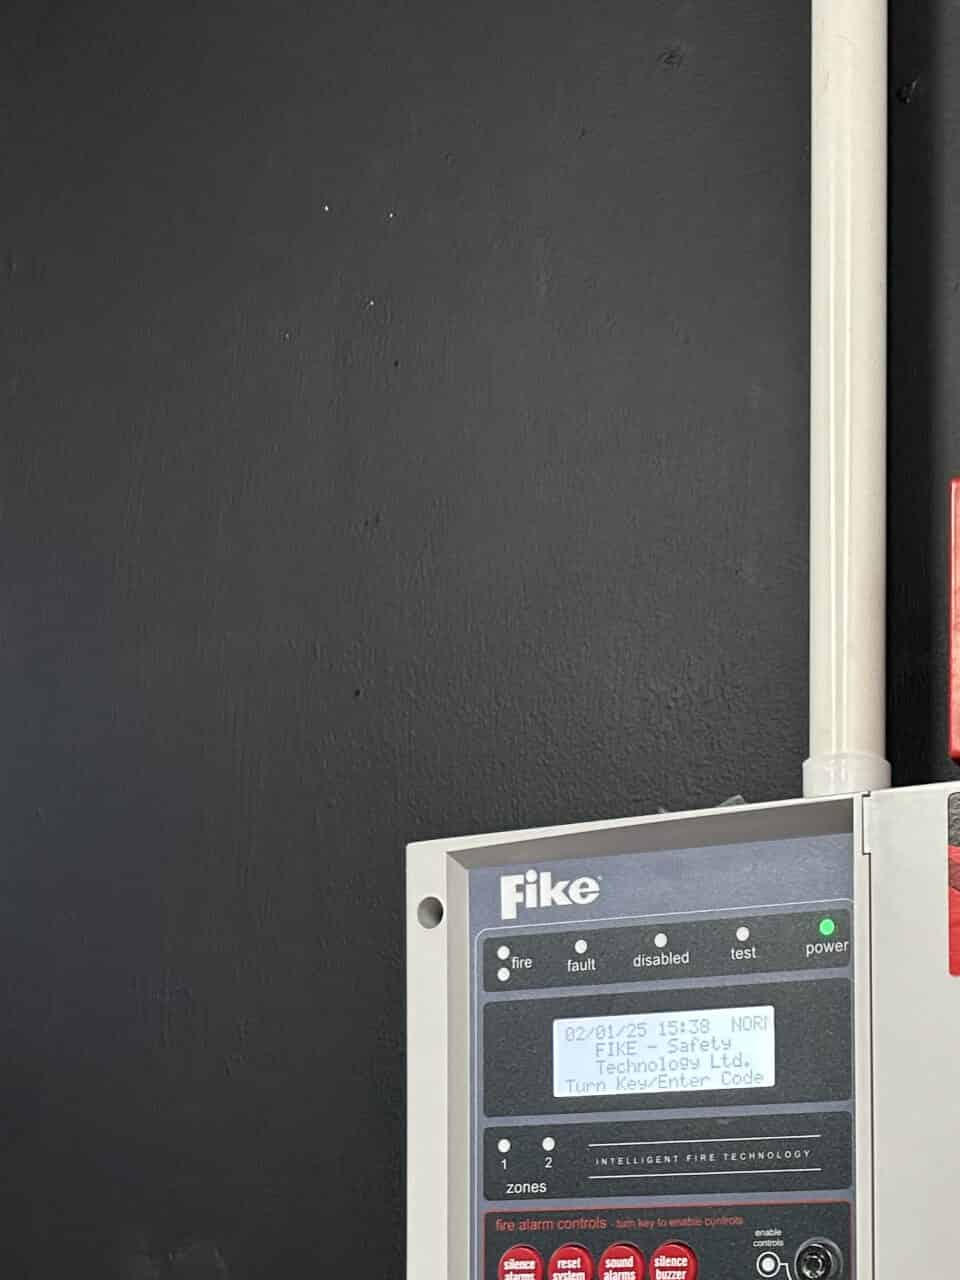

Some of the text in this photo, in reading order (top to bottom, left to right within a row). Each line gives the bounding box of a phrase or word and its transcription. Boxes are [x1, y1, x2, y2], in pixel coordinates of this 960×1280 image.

[501, 869, 600, 919] Fike
[730, 947, 756, 960] test
[806, 940, 848, 958] power
[512, 956, 532, 968] fire
[568, 958, 596, 972] fault
[633, 952, 689, 968] disabled
[565, 1022, 647, 1041] 02/01/25
[596, 1040, 638, 1057] FIKE
[667, 1037, 731, 1054] Safety
[596, 1052, 750, 1075] Technology Ltd.
[566, 1071, 764, 1093] Turn Key/Enter Code
[501, 1158, 508, 1169] 1
[545, 1157, 552, 1168] 2
[596, 1150, 811, 1166] INTELLIGENT FIRE TECHNOLOGY
[506, 1181, 547, 1194] zones
[496, 1218, 515, 1231] fire
[519, 1218, 553, 1231] alarm
[557, 1216, 607, 1229] controls
[704, 1216, 743, 1226] controls
[754, 1228, 782, 1237] enable
[752, 1238, 783, 1248] controls
[504, 1259, 536, 1270] silence
[557, 1257, 581, 1268] reset
[605, 1256, 634, 1268] sound
[654, 1255, 688, 1267] silence
[603, 1270, 635, 1280] alarms
[655, 1268, 686, 1280] buzzer
